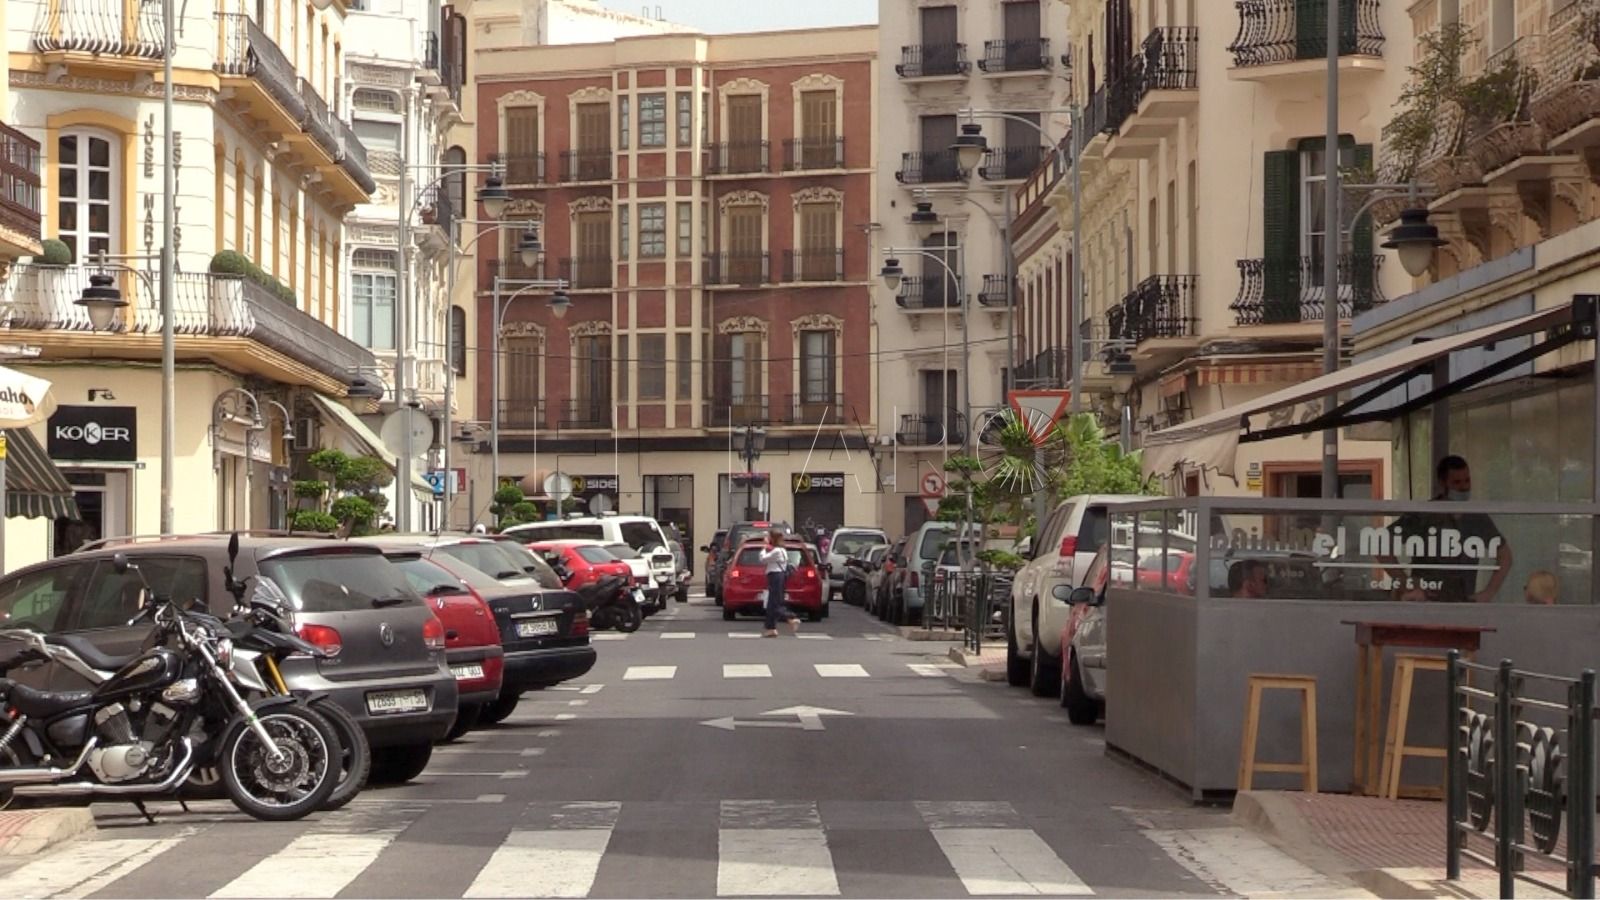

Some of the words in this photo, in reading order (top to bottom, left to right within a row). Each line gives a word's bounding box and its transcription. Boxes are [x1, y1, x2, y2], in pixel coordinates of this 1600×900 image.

[143, 112, 155, 179] JOSE
[55, 422, 131, 445] KOKER
[1312, 525, 1346, 557] el
[1359, 526, 1501, 559] MiniBar
[1420, 577, 1444, 591] bar
